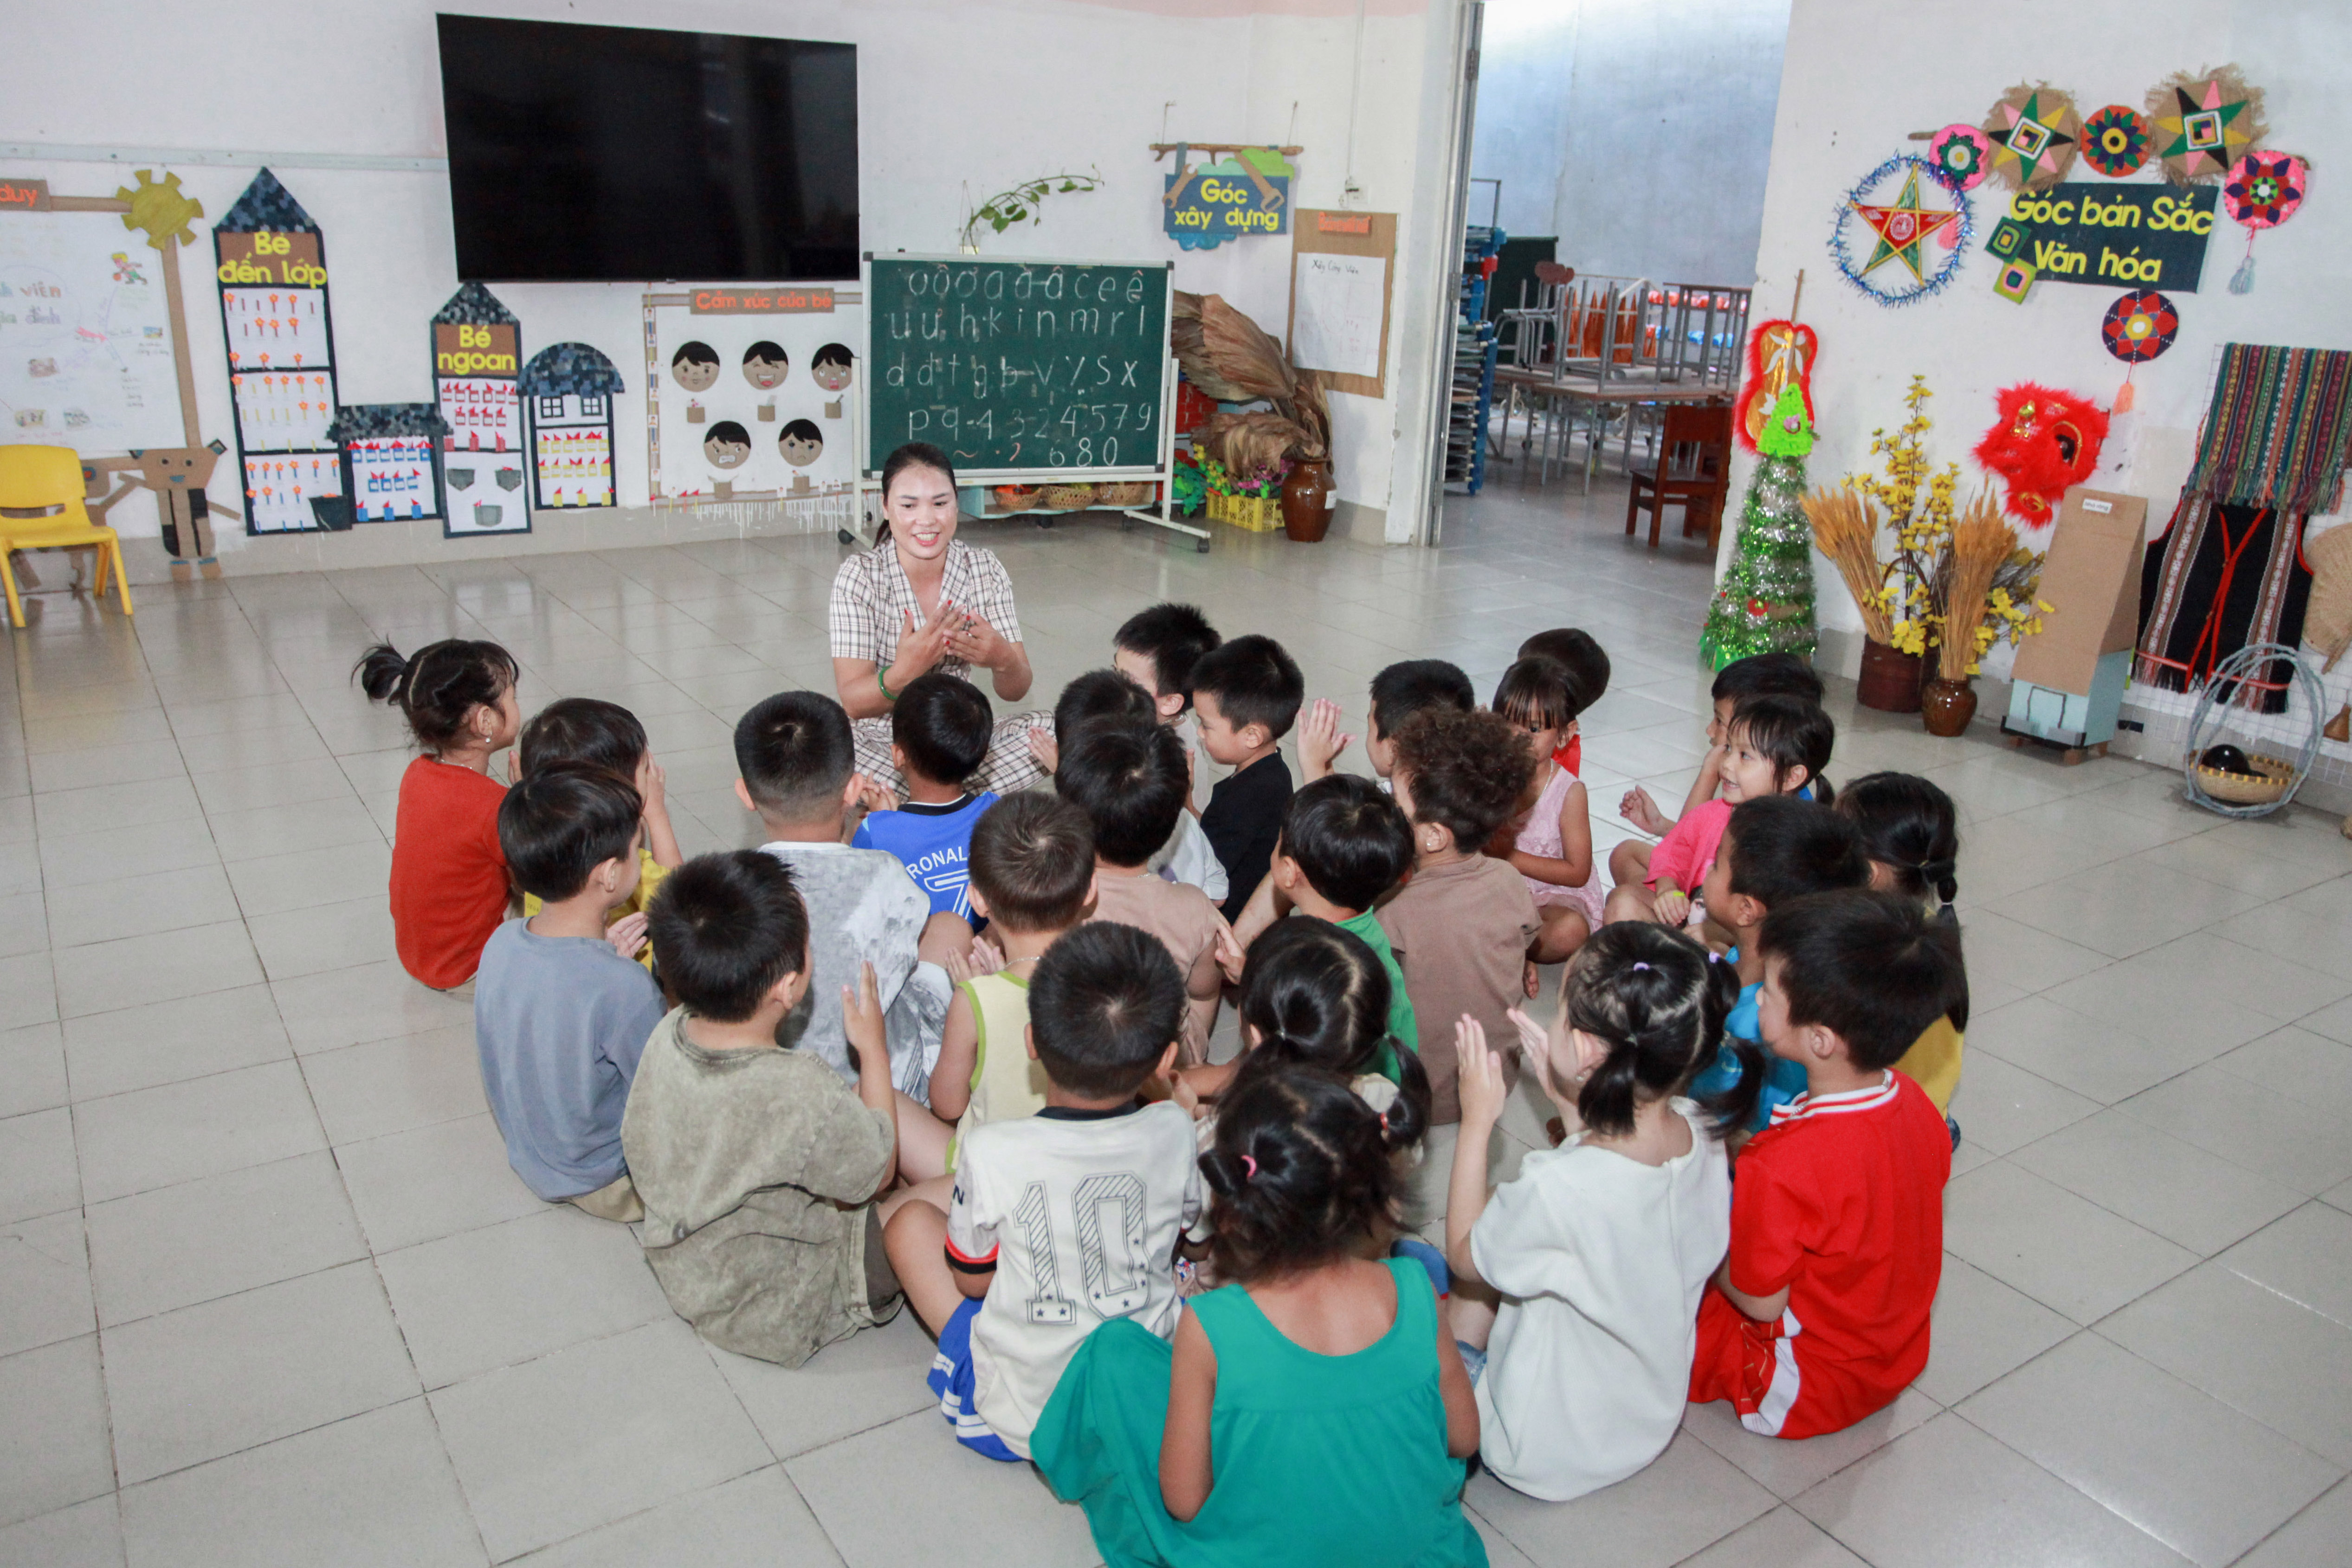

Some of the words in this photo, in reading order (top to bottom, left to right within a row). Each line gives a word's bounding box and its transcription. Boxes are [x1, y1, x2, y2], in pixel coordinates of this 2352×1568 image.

[1200, 178, 1248, 205] Góc
[1174, 206, 1213, 230] xây
[1225, 207, 1279, 232] dựng
[2010, 190, 2075, 225] Góc
[2079, 194, 2141, 228] bản
[2147, 192, 2215, 235] Sắc
[218, 252, 273, 283] đến
[281, 258, 328, 289] lớp
[2035, 240, 2087, 275] Văn
[2098, 246, 2162, 282] hóa
[696, 290, 737, 310] Cảm
[743, 292, 771, 309] xúc
[777, 291, 807, 308] của
[812, 291, 832, 308] bé
[459, 325, 491, 348] Bé
[438, 352, 516, 375] ngoan
[905, 846, 971, 879] RONAL
[1013, 1170, 1152, 1325] 10
